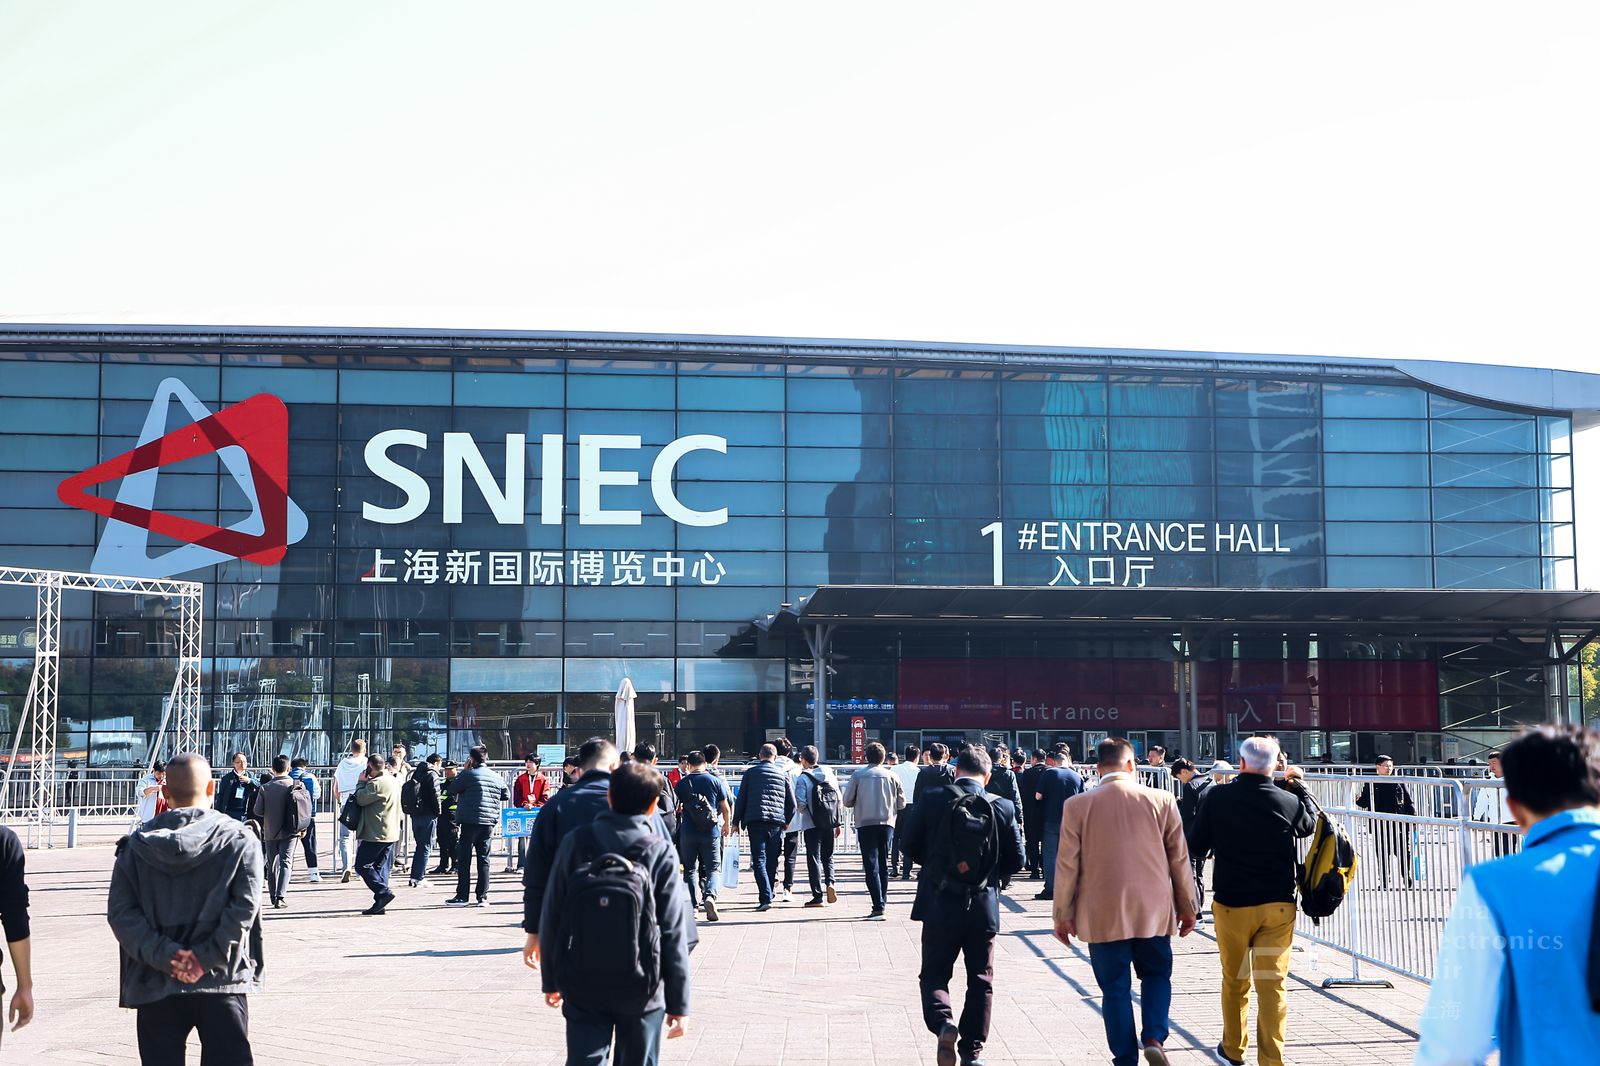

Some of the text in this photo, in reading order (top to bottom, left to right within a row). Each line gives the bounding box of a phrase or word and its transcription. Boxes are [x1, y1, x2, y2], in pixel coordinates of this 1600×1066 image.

[362, 429, 728, 527] SNIEC
[1018, 521, 1291, 552] #ENTRANCE HALL
[361, 548, 726, 586] 上海新国际博览中心
[980, 523, 1004, 586] 1
[1048, 555, 1154, 588] 入口厅
[1011, 700, 1119, 720] Entrance
[1238, 698, 1297, 724] 入口
